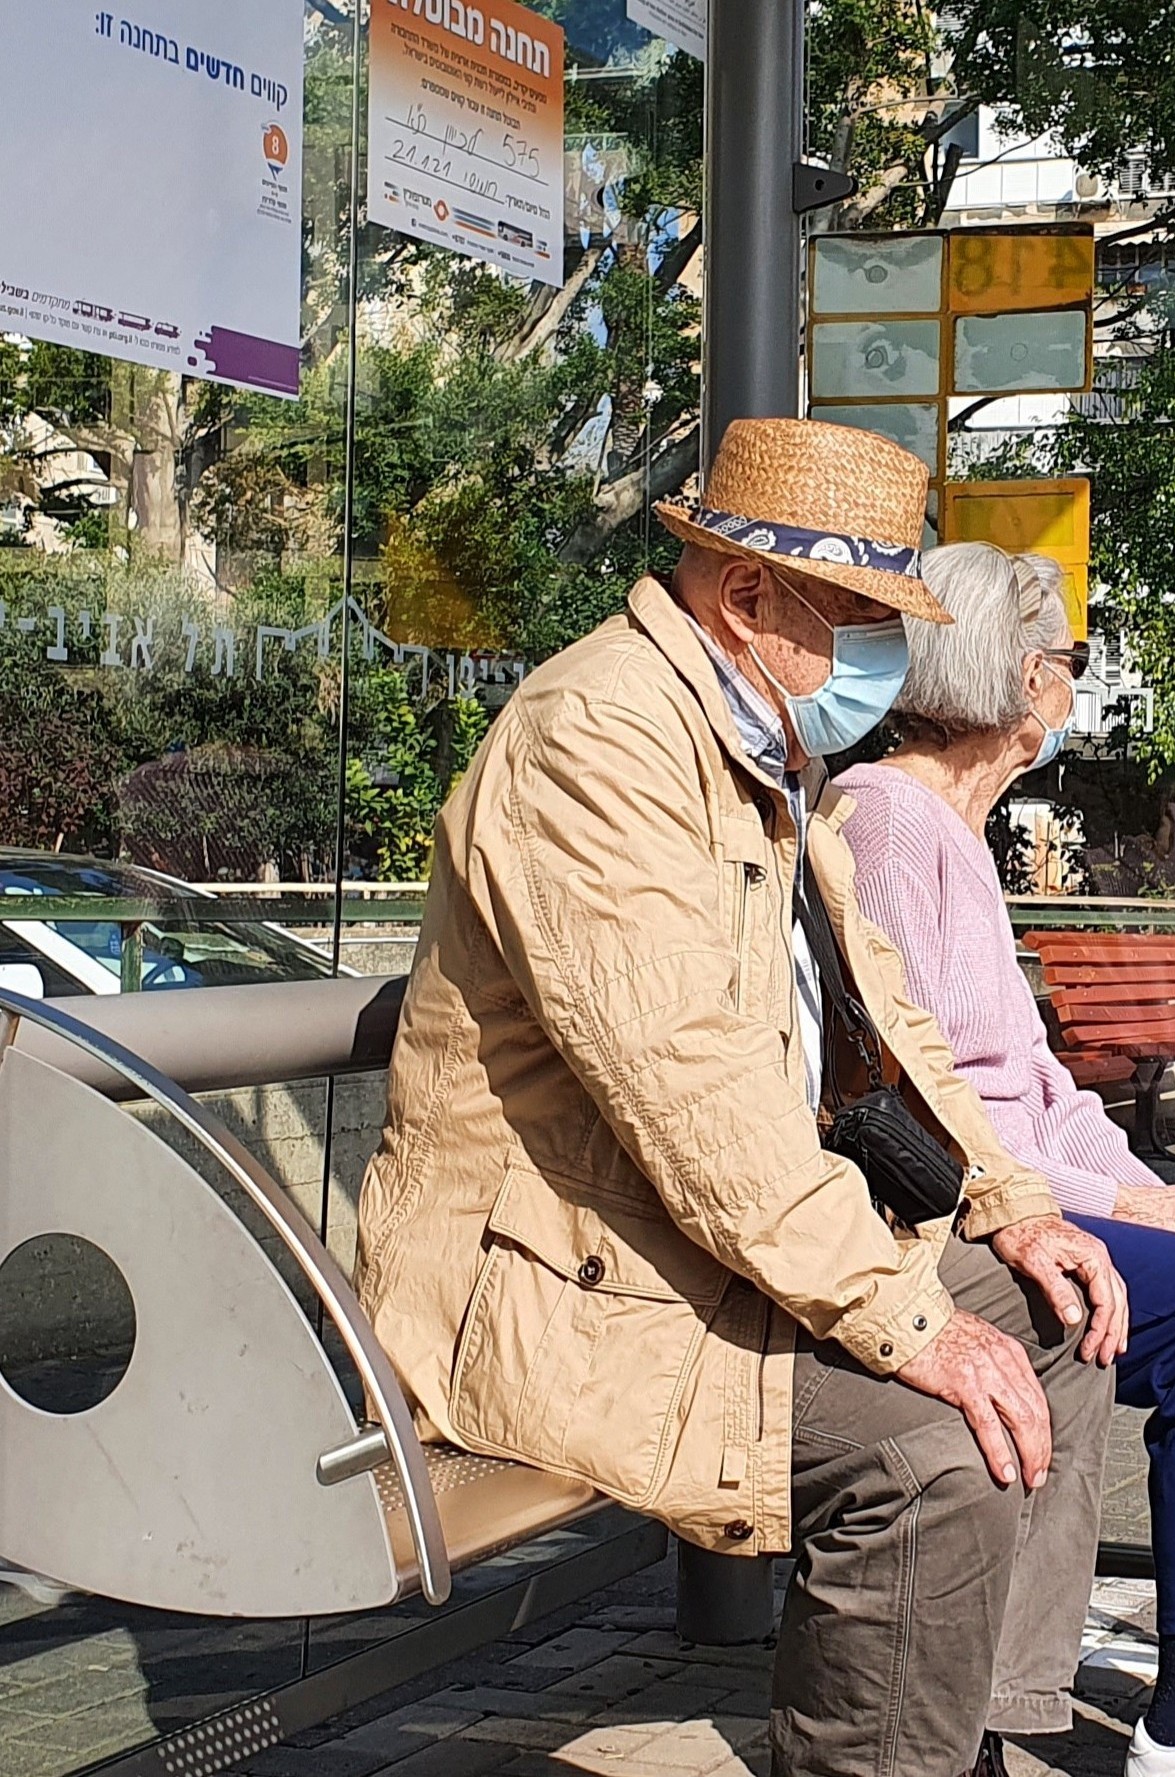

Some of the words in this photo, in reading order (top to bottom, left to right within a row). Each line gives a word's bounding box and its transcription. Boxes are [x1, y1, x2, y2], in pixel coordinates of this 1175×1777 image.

[95, 11, 114, 38] זו:
[119, 20, 180, 65] בתחנה
[386, 0, 485, 46] מבוט
[421, 36, 439, 54] משרד
[440, 42, 449, 59] של
[489, 17, 551, 79] תחנה
[185, 46, 245, 91] חדשים
[250, 73, 288, 112] קווים
[270, 134, 280, 155] 8
[392, 139, 452, 178] 21.1.21
[501, 133, 541, 179] 575
[32, 290, 71, 311] מתקדמים
[182, 611, 235, 678] תל
